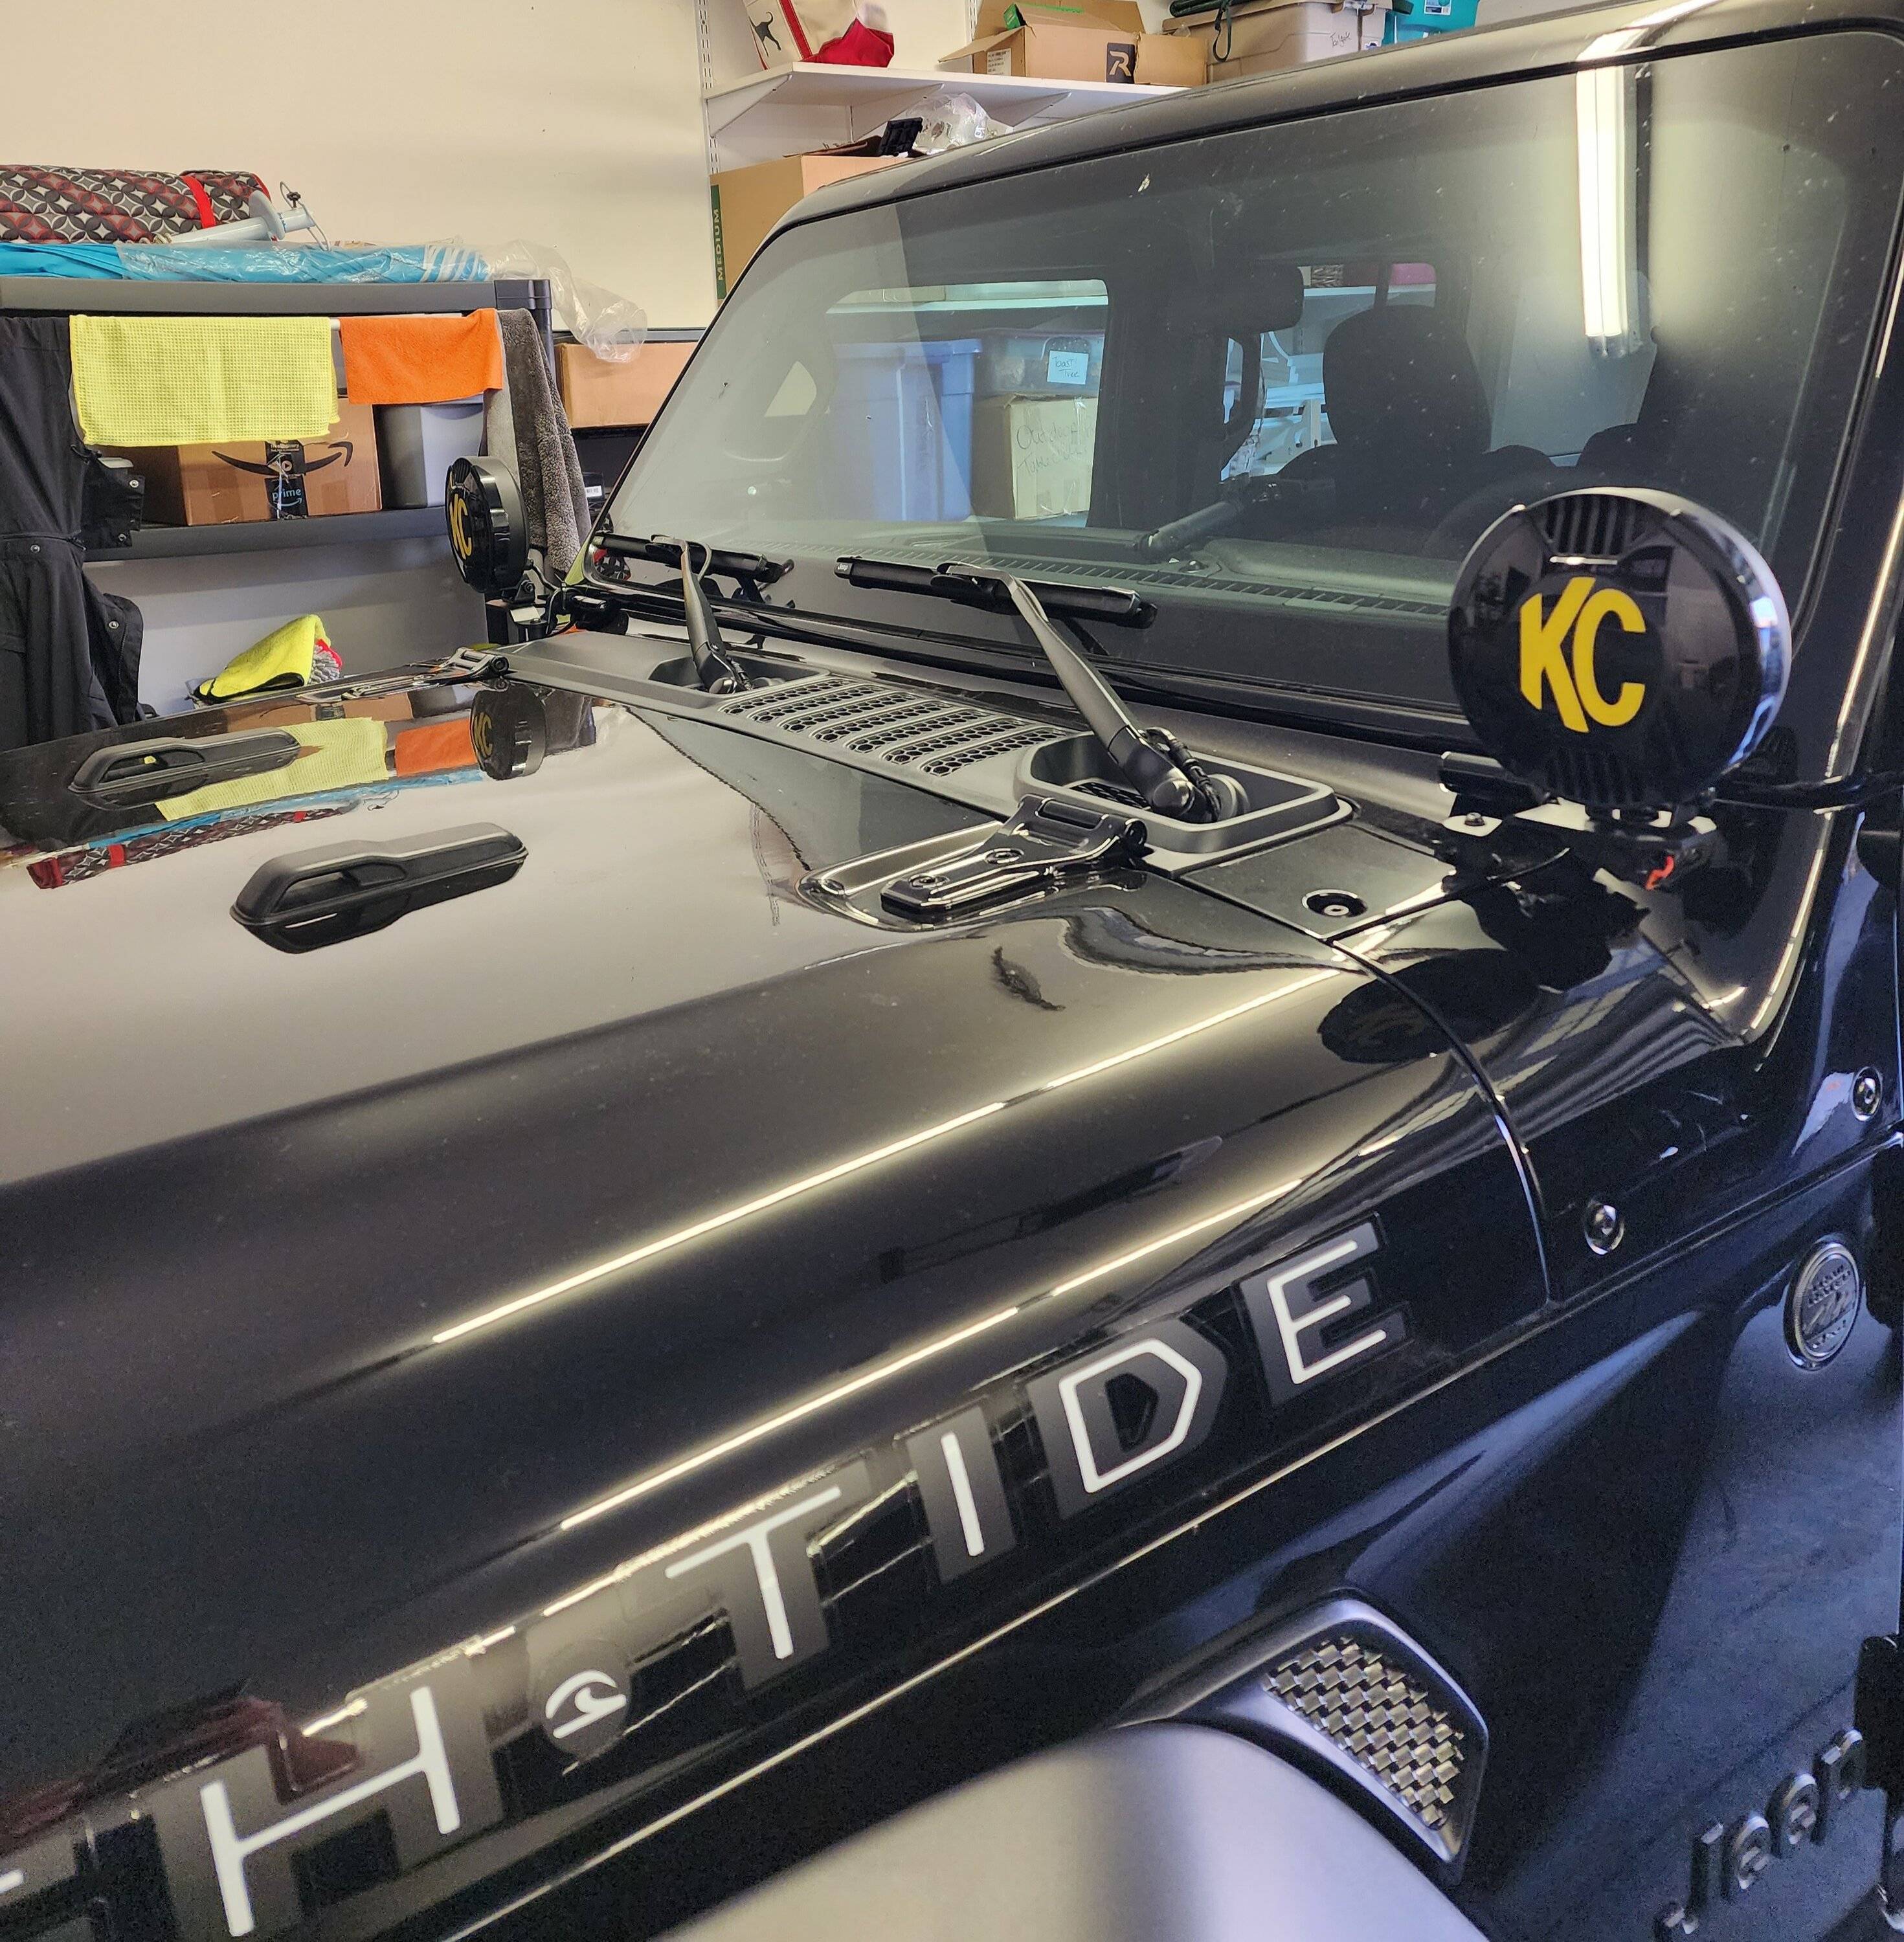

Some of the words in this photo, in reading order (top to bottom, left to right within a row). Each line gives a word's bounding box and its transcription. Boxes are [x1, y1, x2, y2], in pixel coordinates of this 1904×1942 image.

[713, 208, 724, 280] MEDIUM
[272, 488, 302, 502] pime
[449, 493, 472, 560] KC
[1519, 575, 1646, 733] KC
[641, 1220, 1405, 1680] TIDE
